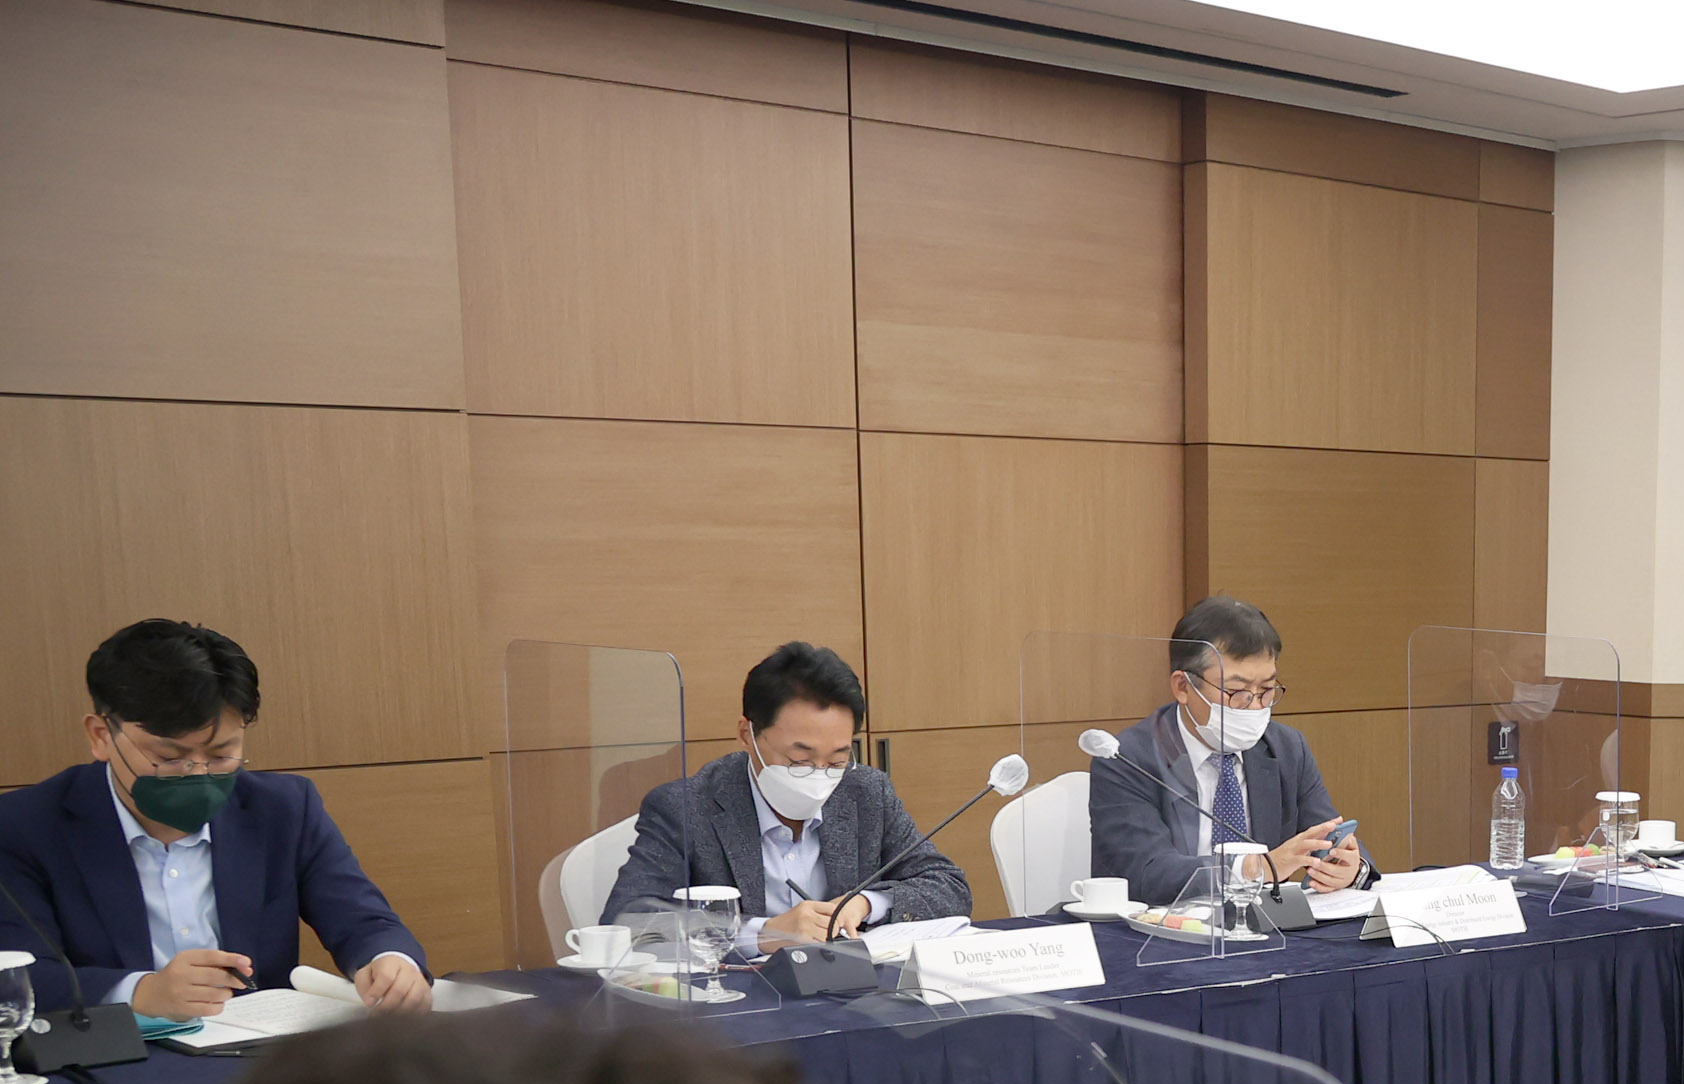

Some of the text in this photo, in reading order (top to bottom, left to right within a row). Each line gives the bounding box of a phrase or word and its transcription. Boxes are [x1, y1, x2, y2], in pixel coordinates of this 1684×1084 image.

[1442, 893, 1464, 908] chul
[1466, 893, 1497, 905] Moon
[953, 942, 1065, 965] Dong-woo Yang
